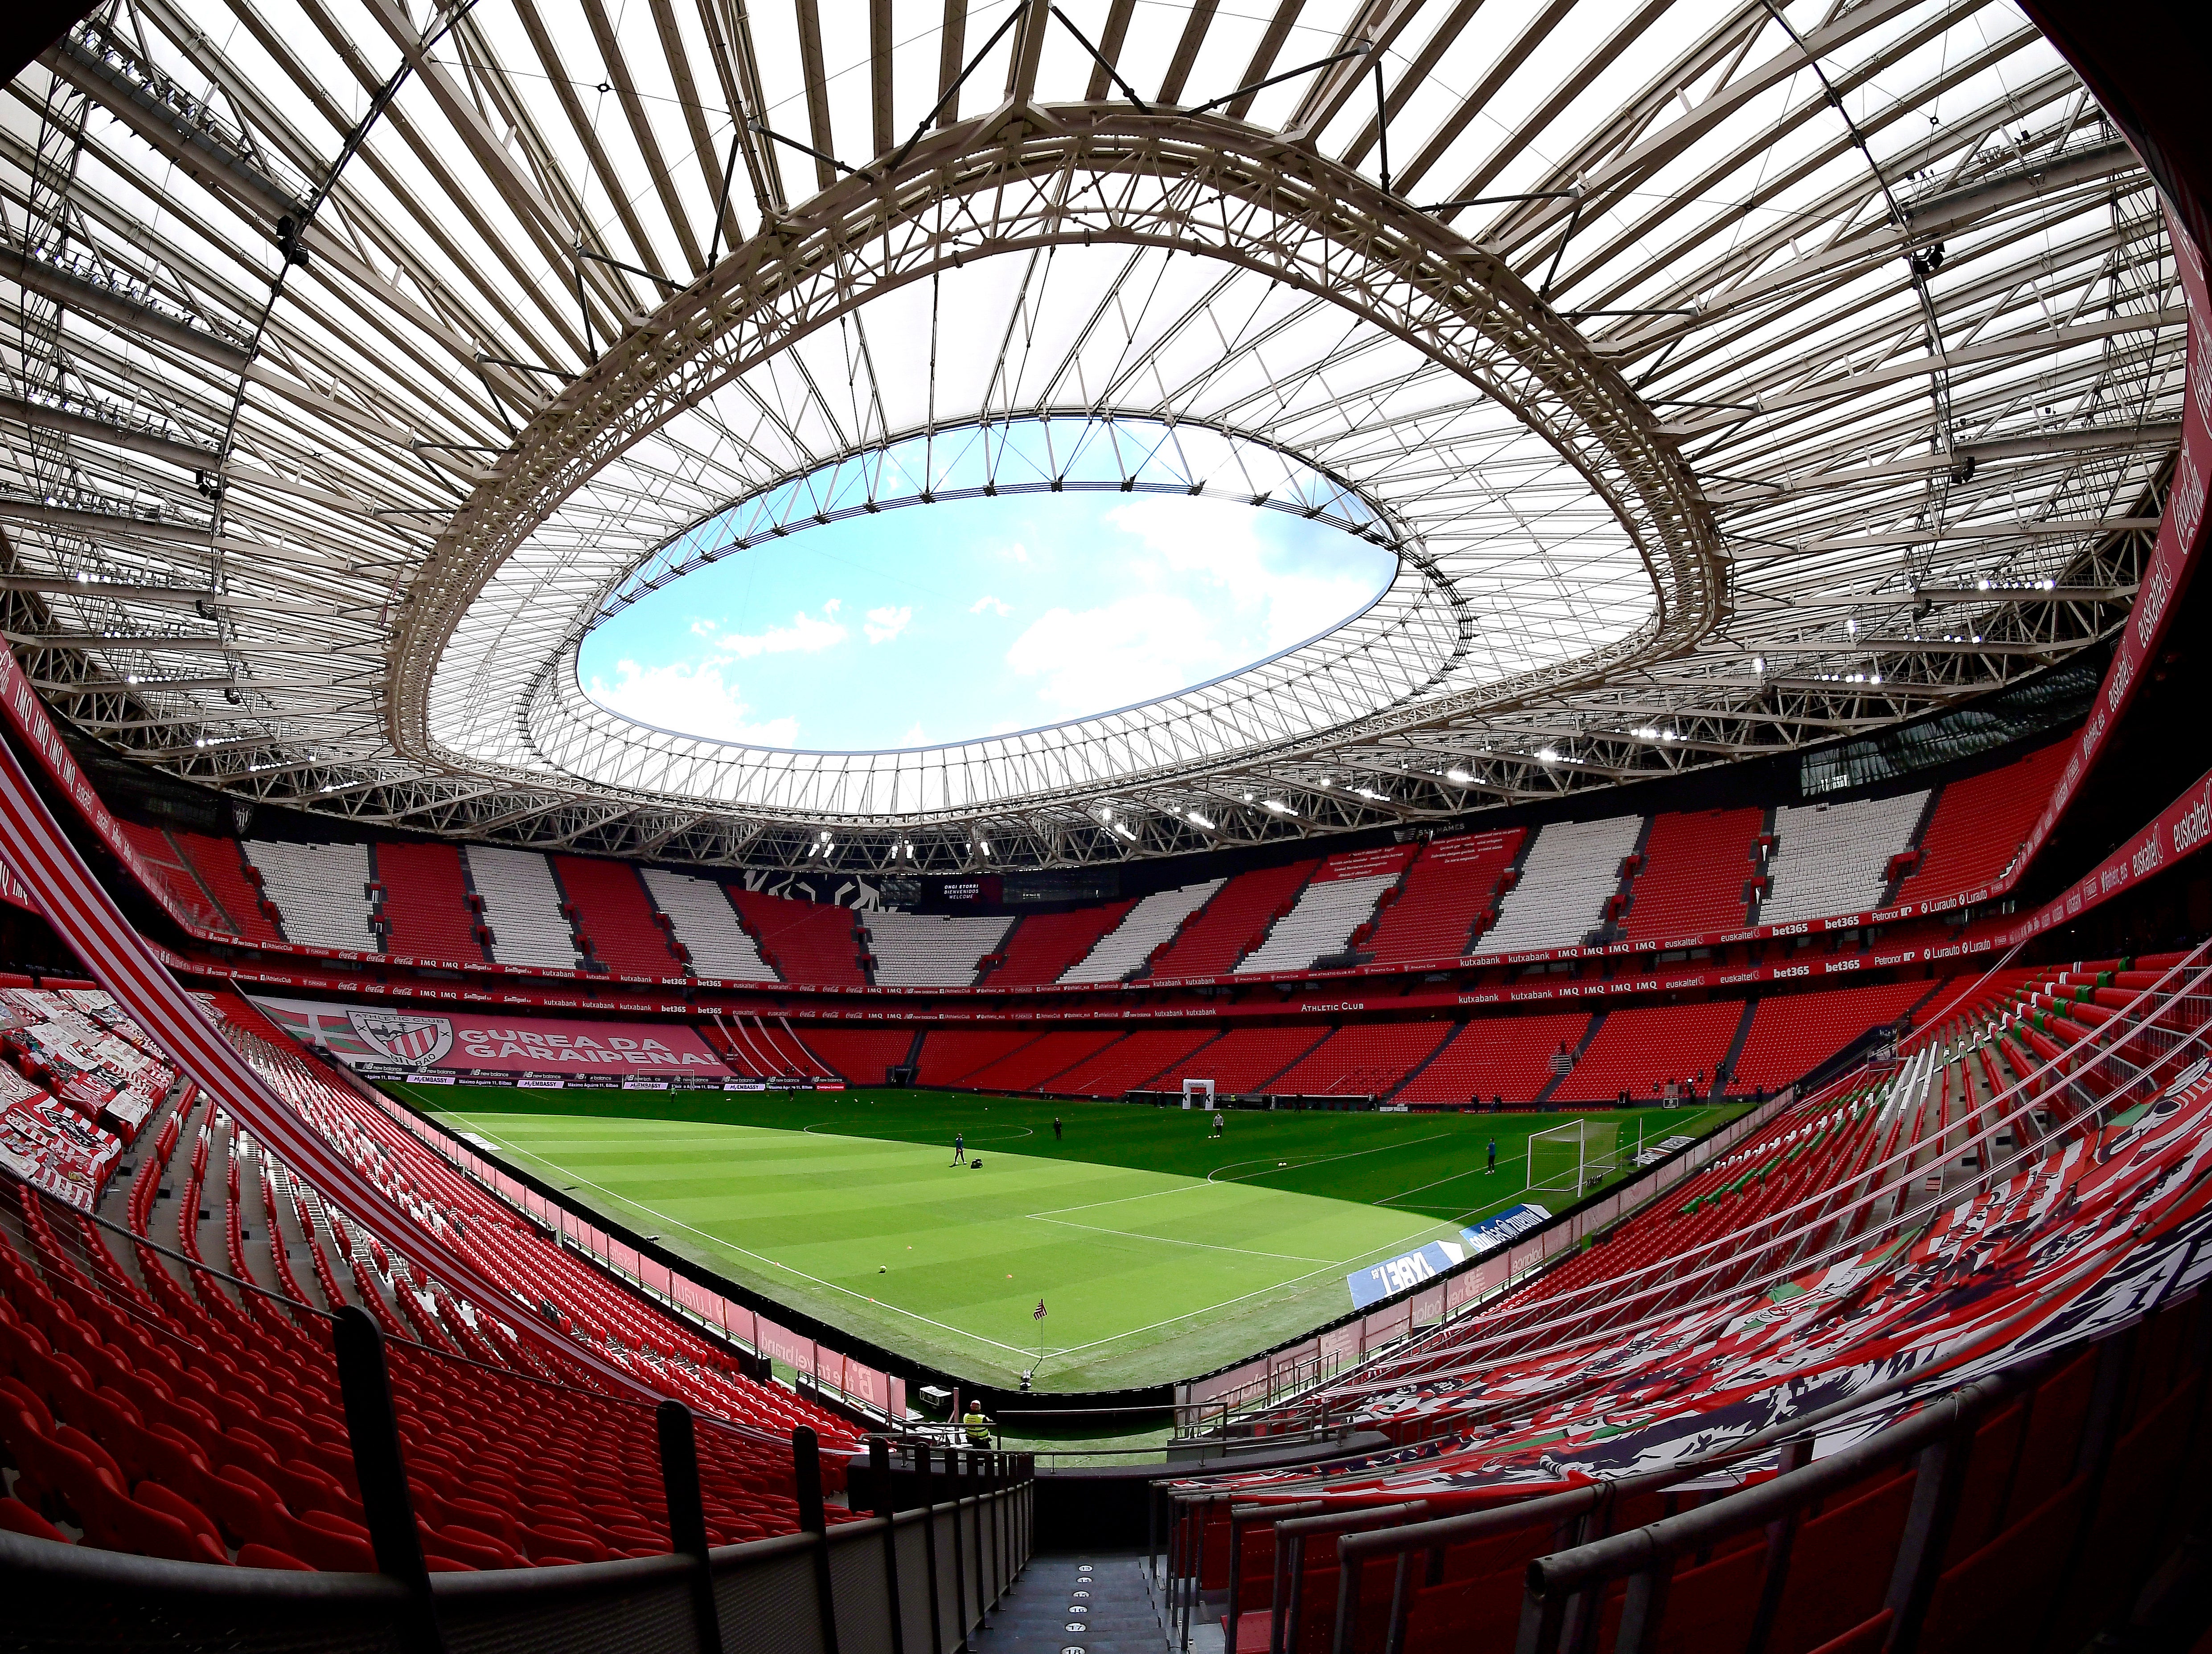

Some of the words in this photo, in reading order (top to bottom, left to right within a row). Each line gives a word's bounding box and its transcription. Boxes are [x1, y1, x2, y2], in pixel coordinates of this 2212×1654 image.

[14, 680, 33, 732] IMQ
[33, 710, 50, 755] IMQ
[49, 735, 63, 774] IMQ
[64, 757, 76, 793] IMQ
[2173, 791, 2211, 852] euskaltel
[2133, 833, 2158, 877] euskaltel
[1966, 888, 1987, 904] Lurauto
[1929, 898, 1957, 913] Lurauto
[1872, 910, 1898, 921] Petronor
[1825, 916, 1859, 929] bet365
[1772, 923, 1808, 936] bet365
[1721, 931, 1753, 942] euskaltel
[1609, 943, 1629, 954] IMQ
[1635, 941, 1656, 951] IMQ
[1665, 937, 1697, 949] euskaltel
[1970, 938, 1991, 953] Lurauto
[1558, 949, 1578, 958] IMQ
[1583, 946, 1603, 956] IMQ
[1933, 945, 1960, 959] Lurauto
[1460, 955, 1500, 967] kutxabank
[1508, 952, 1550, 963] kutxabank
[1875, 954, 1901, 965] Petronor
[1825, 959, 1860, 972] bet365
[542, 969, 575, 978] kutxabank
[1720, 972, 1753, 983] euskaltel
[1773, 966, 1810, 978] bet365
[662, 977, 687, 985] bet365
[698, 979, 722, 987] bet365
[1186, 977, 1215, 985] kutxabank
[1637, 980, 1658, 990] IMQ
[1666, 978, 1698, 989] euskaltel
[1559, 987, 1580, 996] IMQ
[1584, 985, 1605, 995] IMQ
[1611, 983, 1631, 992] IMQ
[1458, 993, 1499, 1003] kutxabank
[1511, 990, 1553, 1000] kutxabank
[582, 1001, 615, 1009] kutxabank
[355, 1012, 410, 1022] ATHLETIC
[458, 1029, 605, 1051] GUREA
[607, 1036, 671, 1051] DA
[464, 1041, 721, 1066] GARAIPENA!
[390, 1052, 436, 1067] BILBAO
